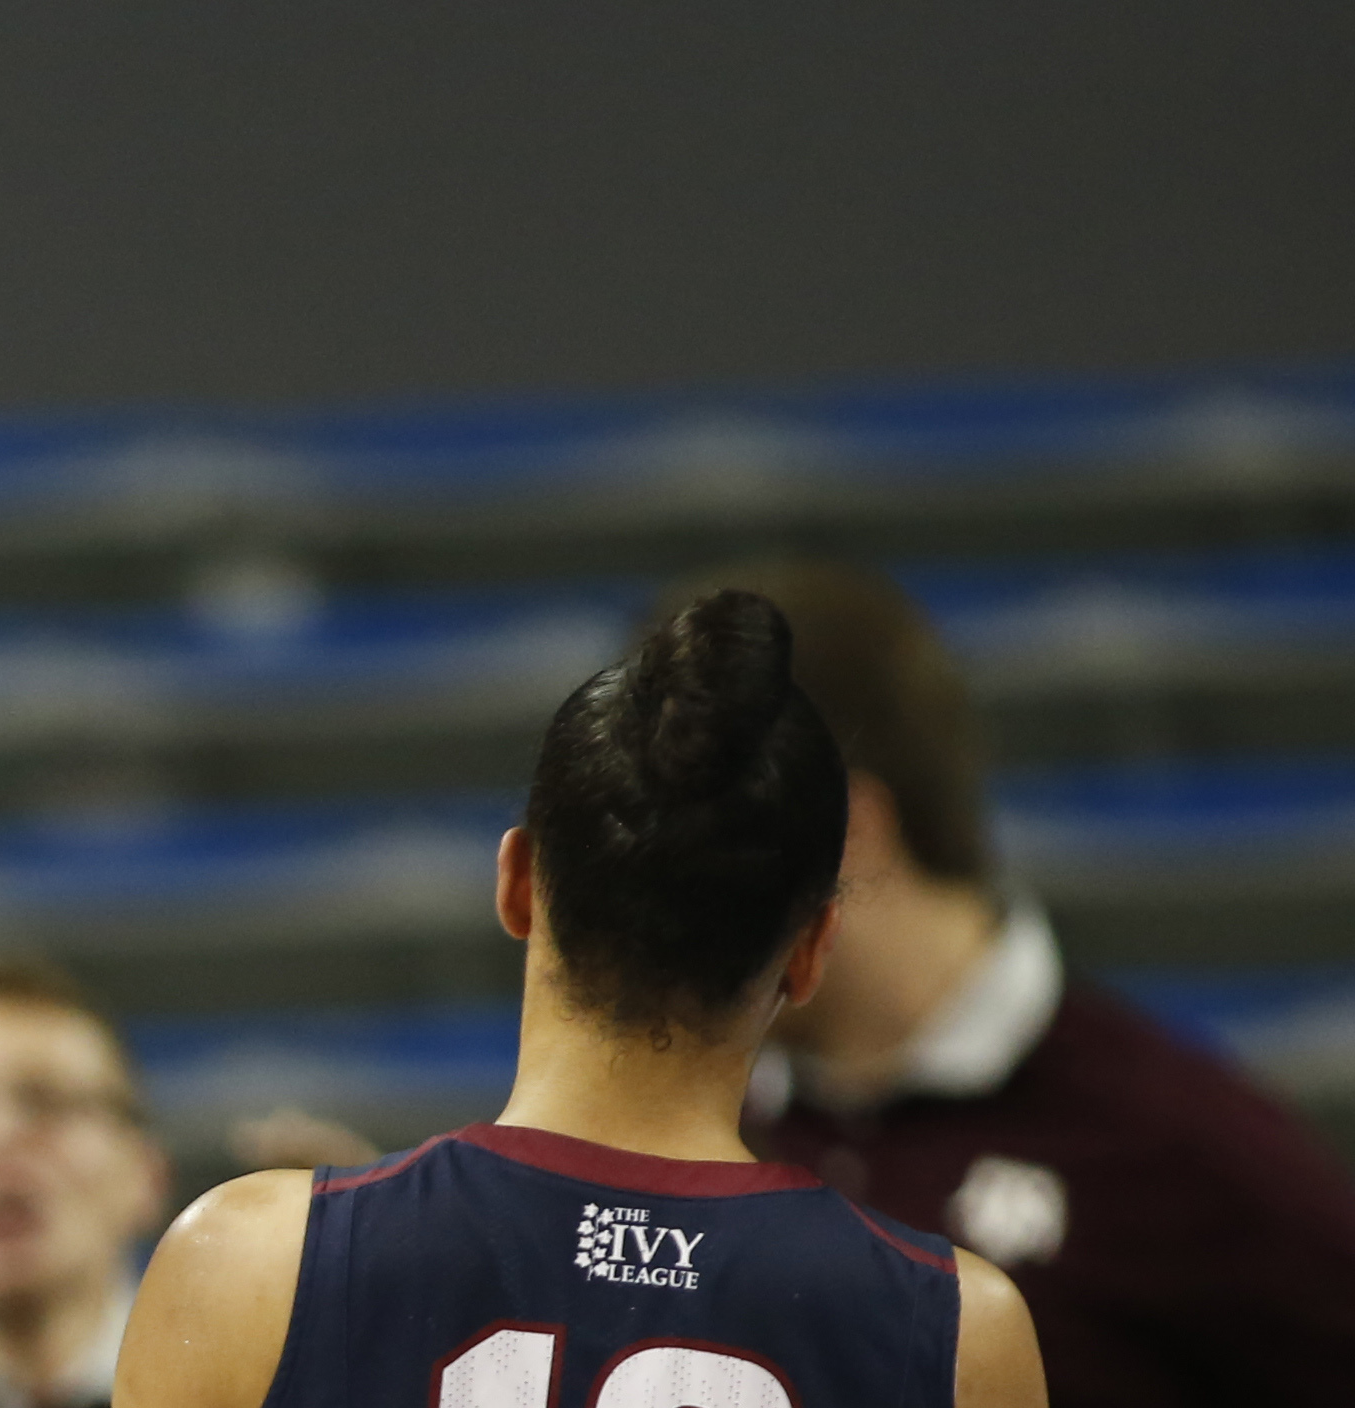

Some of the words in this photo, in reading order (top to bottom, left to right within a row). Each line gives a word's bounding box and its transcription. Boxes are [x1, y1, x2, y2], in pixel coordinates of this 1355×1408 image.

[613, 1207, 651, 1222] THE
[607, 1223, 705, 1268] IVY
[607, 1263, 701, 1290] LEAGUE
